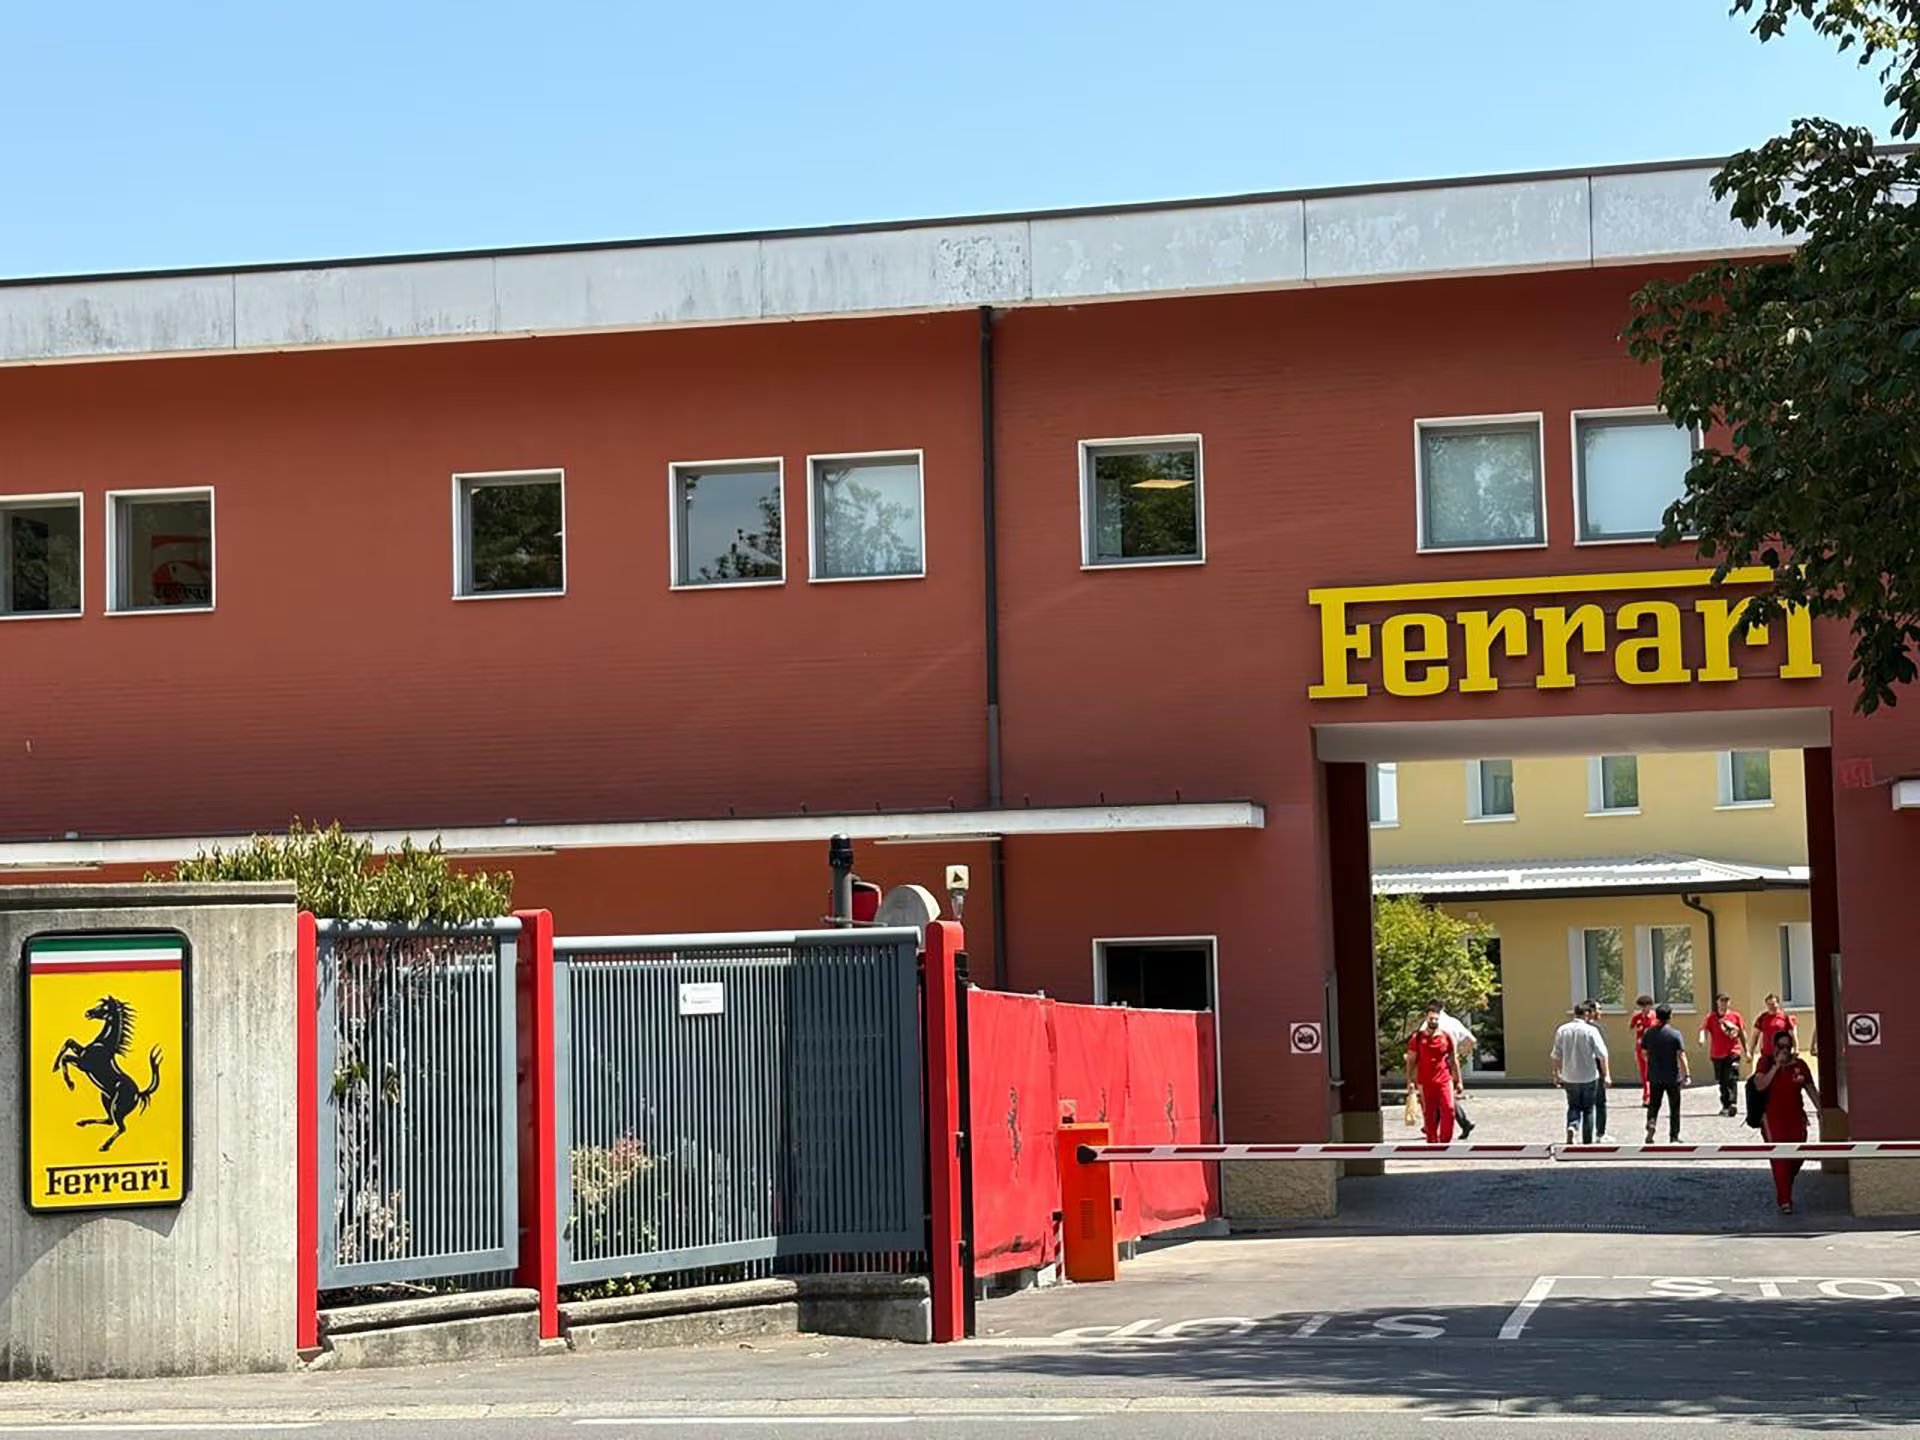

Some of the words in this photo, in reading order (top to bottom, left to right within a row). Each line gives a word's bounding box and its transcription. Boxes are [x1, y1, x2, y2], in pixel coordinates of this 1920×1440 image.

[1308, 565, 1822, 698] Ferrari
[45, 1161, 170, 1196] Ferrari
[1647, 1276, 1920, 1299] STO
